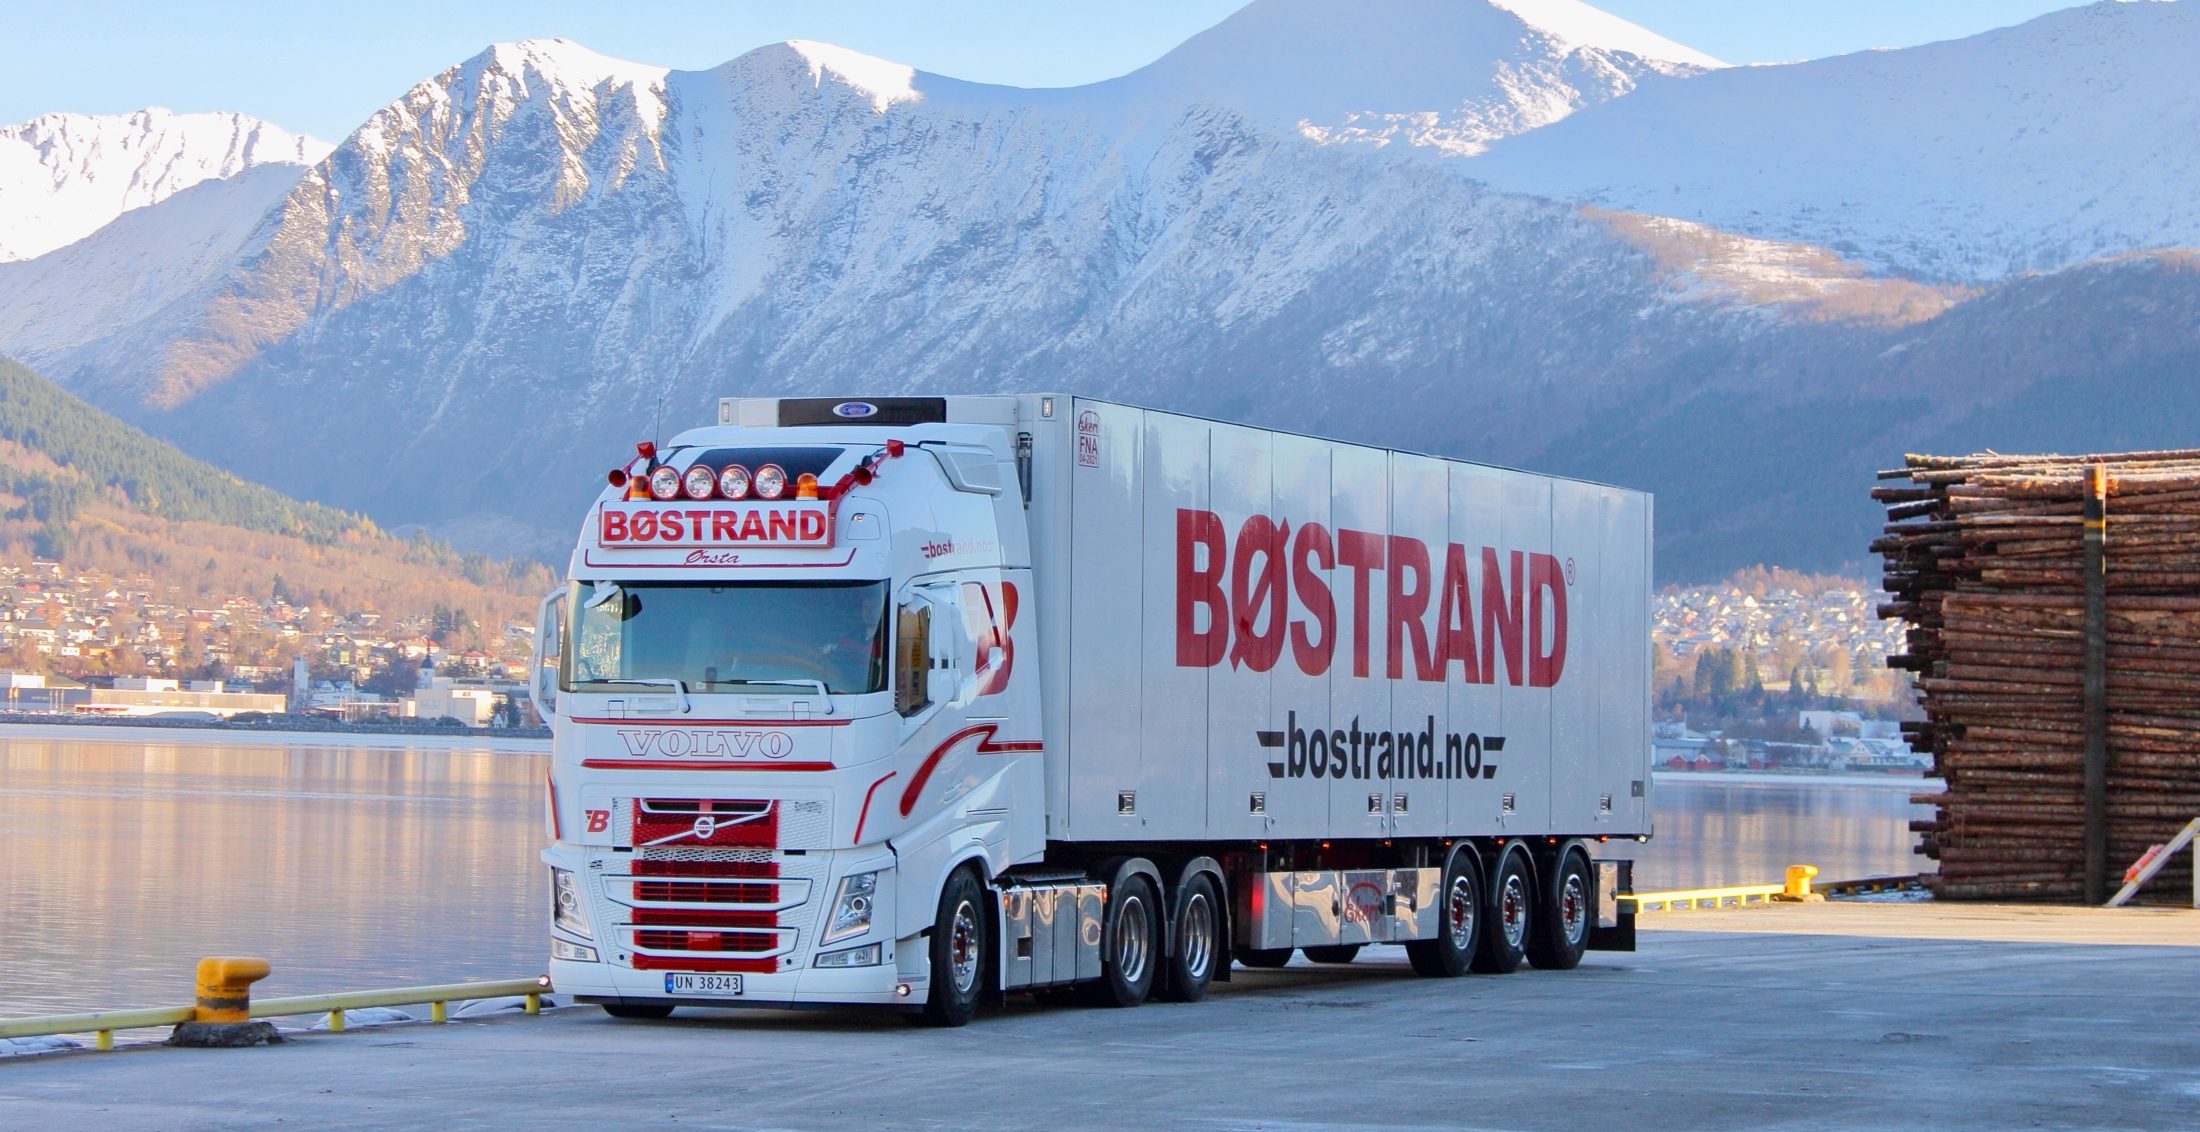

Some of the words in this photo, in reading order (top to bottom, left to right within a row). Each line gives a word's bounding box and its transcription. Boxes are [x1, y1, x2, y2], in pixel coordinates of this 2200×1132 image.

[1079, 436, 1098, 455] FNA
[603, 510, 827, 542] BØSTRAND
[684, 550, 741, 566] Ørsta
[1176, 508, 1568, 688] BØSTRAND
[617, 730, 793, 759] VOLVO
[1288, 710, 1481, 780] bostrand.no
[675, 976, 693, 989] UN
[699, 976, 739, 990] 38243
